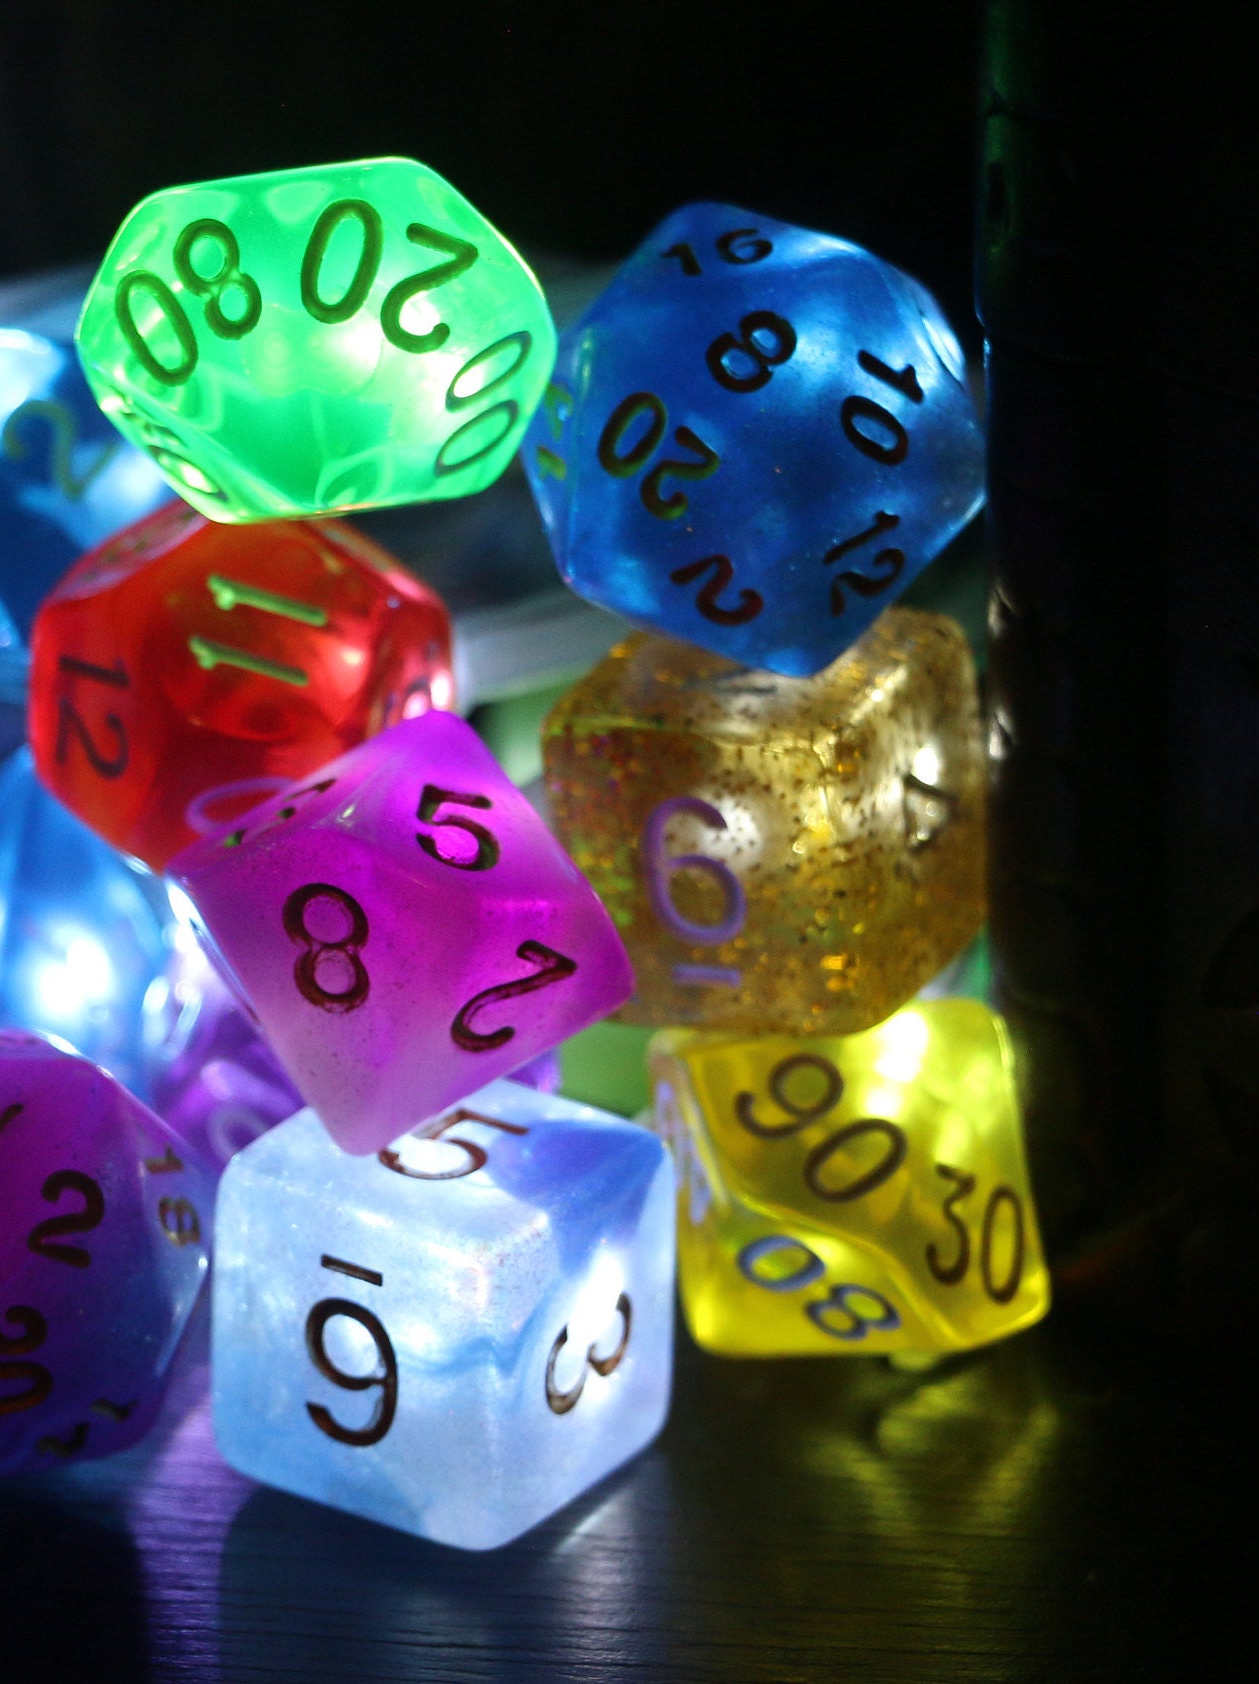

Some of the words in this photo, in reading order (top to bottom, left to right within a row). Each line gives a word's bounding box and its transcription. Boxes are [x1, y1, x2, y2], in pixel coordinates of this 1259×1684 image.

[114, 217, 263, 388] 80
[299, 197, 479, 354] 20
[659, 228, 773, 277] 16
[434, 330, 533, 479] 00
[705, 310, 797, 393] 8
[840, 350, 924, 466] 10
[598, 391, 721, 520] 20
[670, 553, 764, 627] 2
[822, 509, 905, 618] 12
[188, 572, 329, 687] 11
[55, 653, 131, 781] 12
[415, 782, 501, 872] 5
[281, 882, 371, 1015] 8
[450, 939, 578, 1054] 2
[376, 1106, 530, 1181] 5
[733, 1052, 909, 1204] 90
[27, 1169, 106, 1270] 2
[925, 1161, 1026, 1306] 30
[734, 1234, 902, 1341] 80
[544, 1290, 633, 1416] 3
